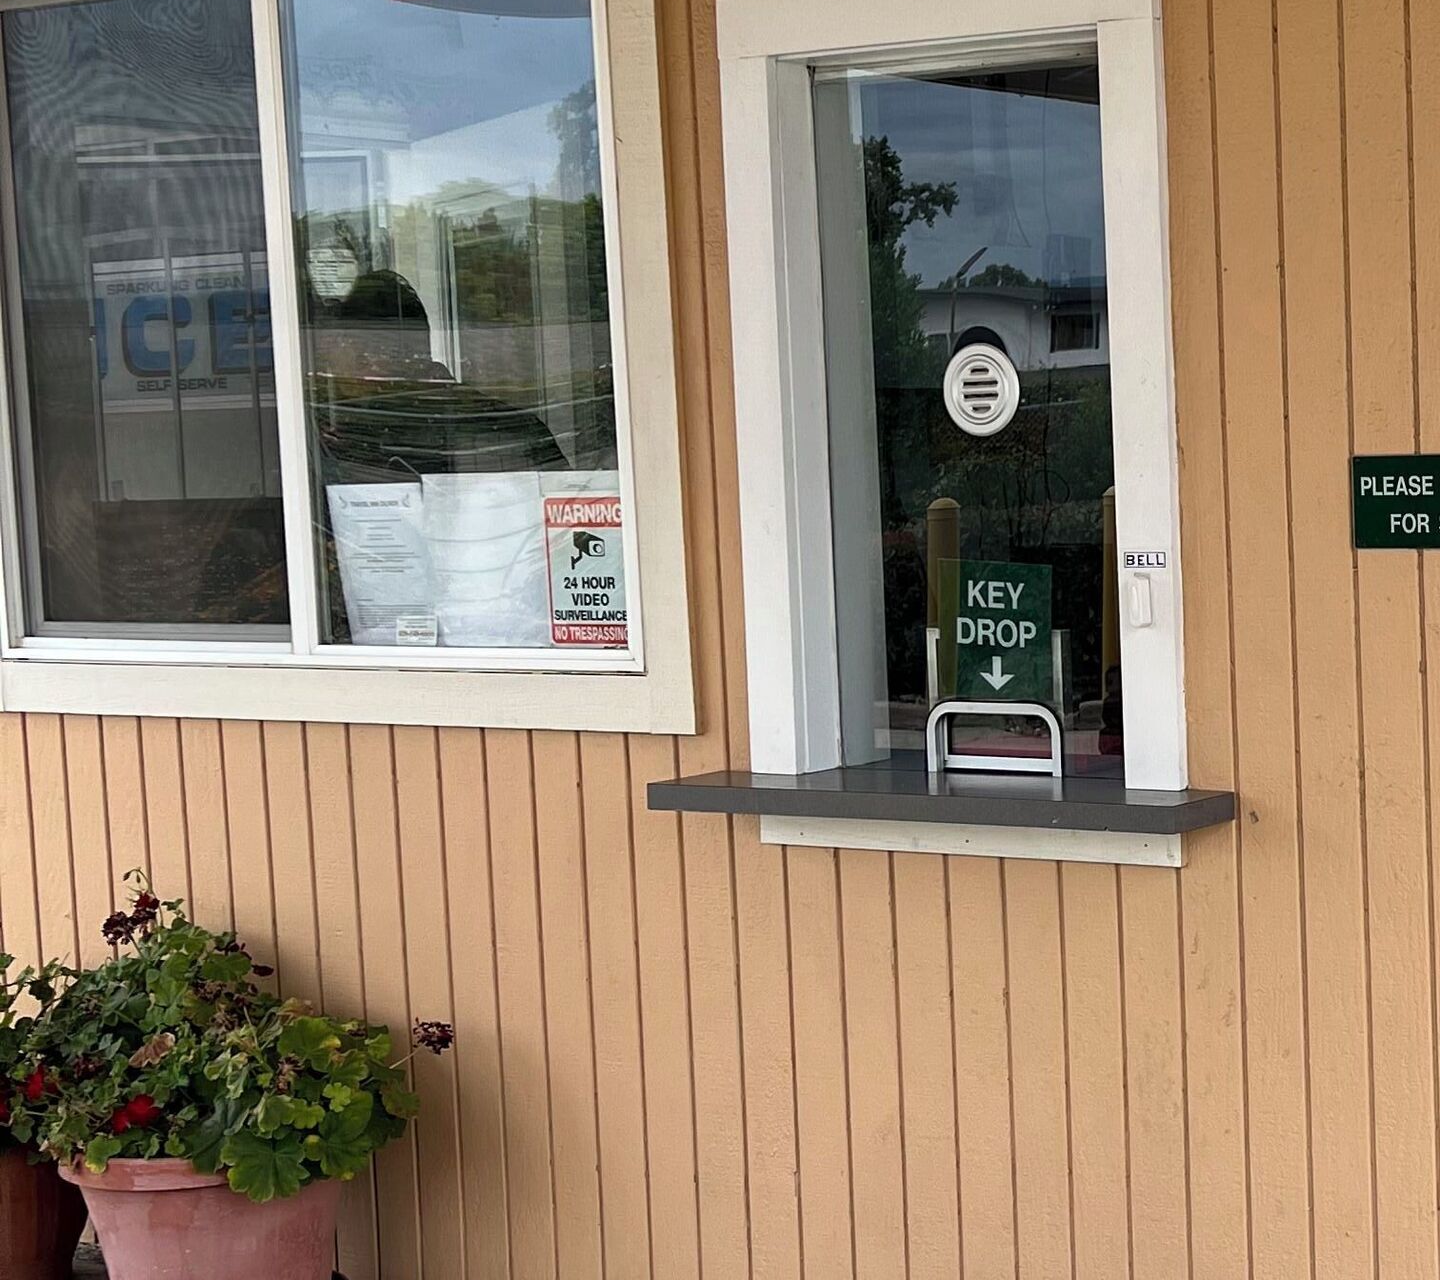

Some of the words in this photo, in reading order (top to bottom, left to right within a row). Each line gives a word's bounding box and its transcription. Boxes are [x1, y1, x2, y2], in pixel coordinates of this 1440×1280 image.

[195, 275, 246, 290] CLEAN
[136, 379, 172, 393] SELF
[177, 377, 228, 391] SERVE
[1360, 475, 1434, 496] PLEASE
[547, 503, 622, 524] WARNING
[1390, 513, 1430, 534] FOR
[1126, 554, 1164, 566] BELL
[564, 577, 578, 590] 24
[582, 576, 615, 589] HOUR
[571, 593, 610, 607] VIDEO
[966, 579, 1025, 611] KEY
[554, 610, 628, 621] SURVEILLANCE
[554, 627, 567, 640] NO
[956, 617, 1037, 649] DROP
